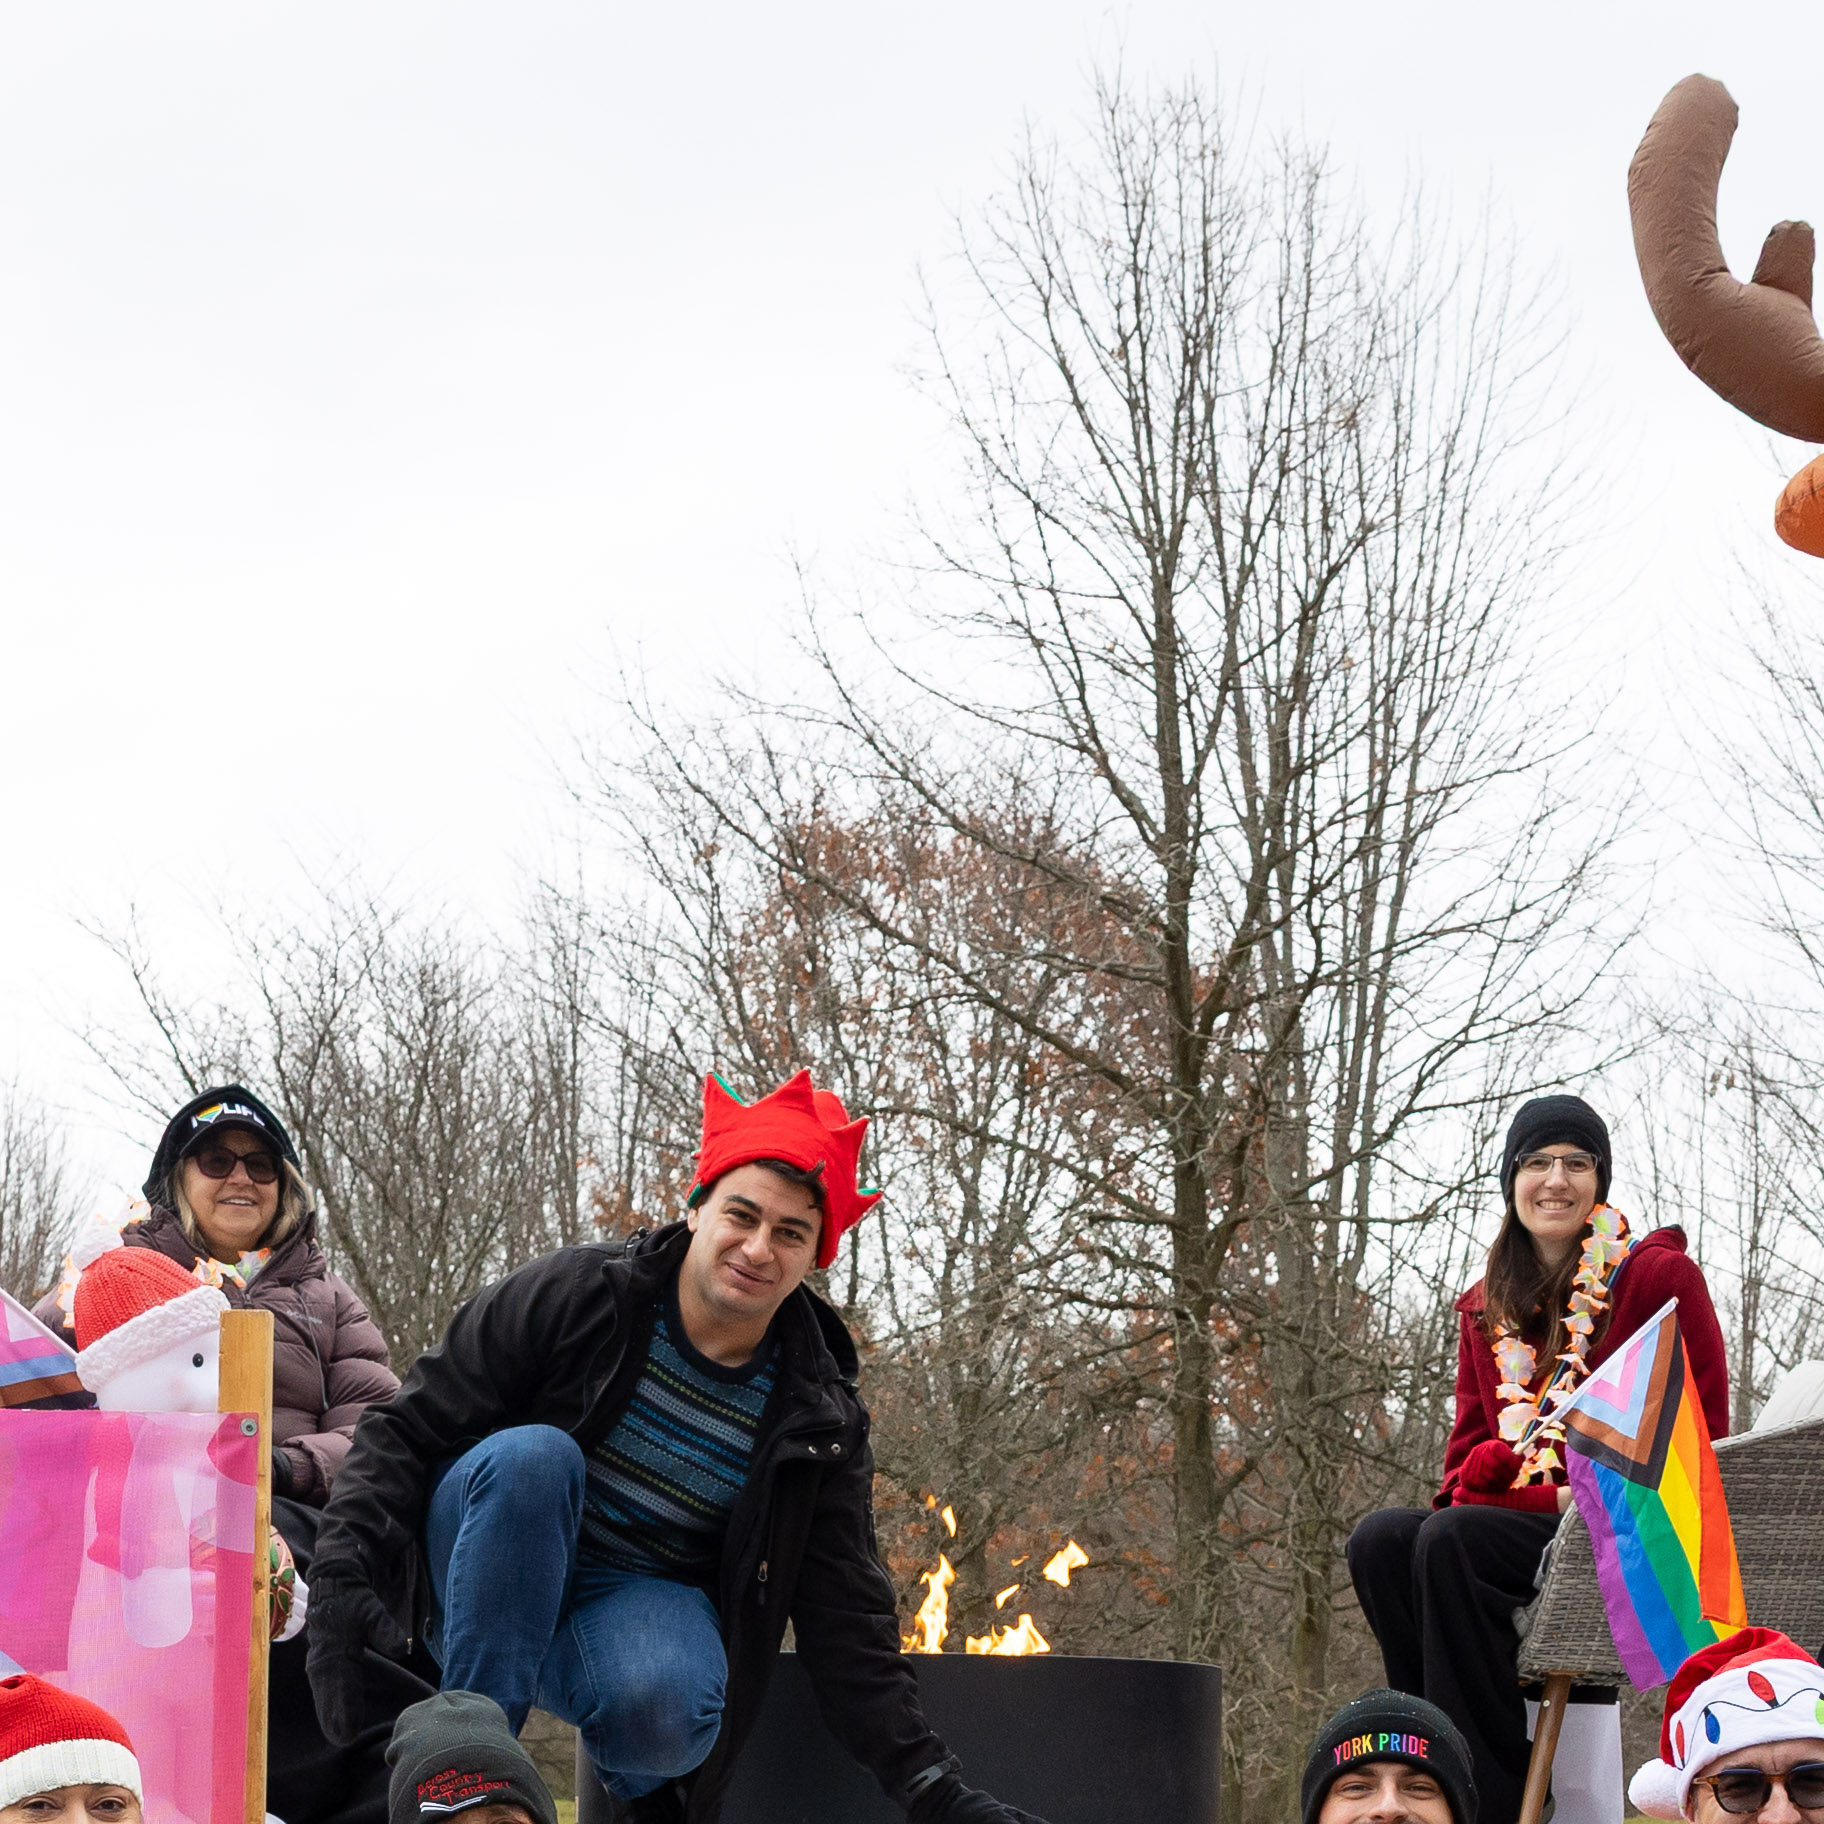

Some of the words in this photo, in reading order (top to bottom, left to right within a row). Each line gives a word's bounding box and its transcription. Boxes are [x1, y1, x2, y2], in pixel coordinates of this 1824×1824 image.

[1333, 1733, 1373, 1765] YORK
[1379, 1732, 1430, 1759] PRIDE
[417, 1768, 457, 1799] Across
[429, 1772, 484, 1800] Country
[441, 1779, 511, 1805] Transport
